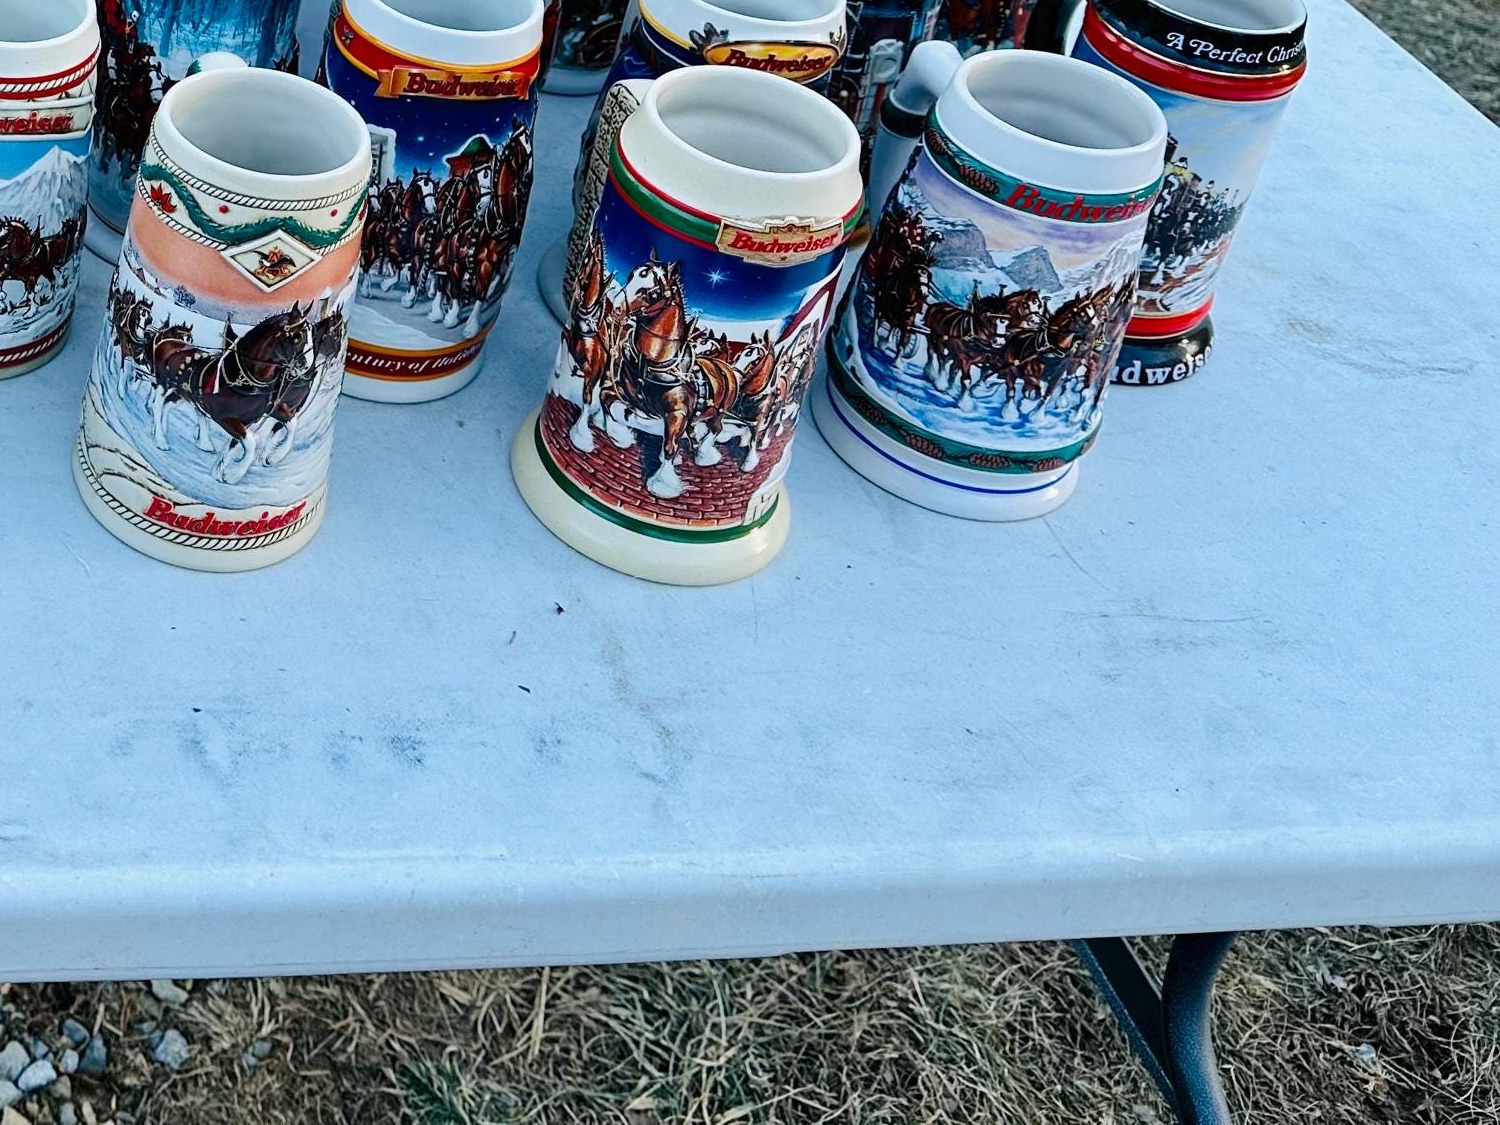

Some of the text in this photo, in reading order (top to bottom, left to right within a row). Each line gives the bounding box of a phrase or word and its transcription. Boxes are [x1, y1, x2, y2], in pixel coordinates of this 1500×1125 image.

[720, 48, 832, 74] Budweiser
[1166, 31, 1185, 50] A
[1188, 38, 1264, 64] Perfect
[404, 69, 522, 97] Budweiser
[728, 229, 839, 254] Budweiser
[408, 357, 433, 373] of
[143, 495, 307, 537] Budweiser
